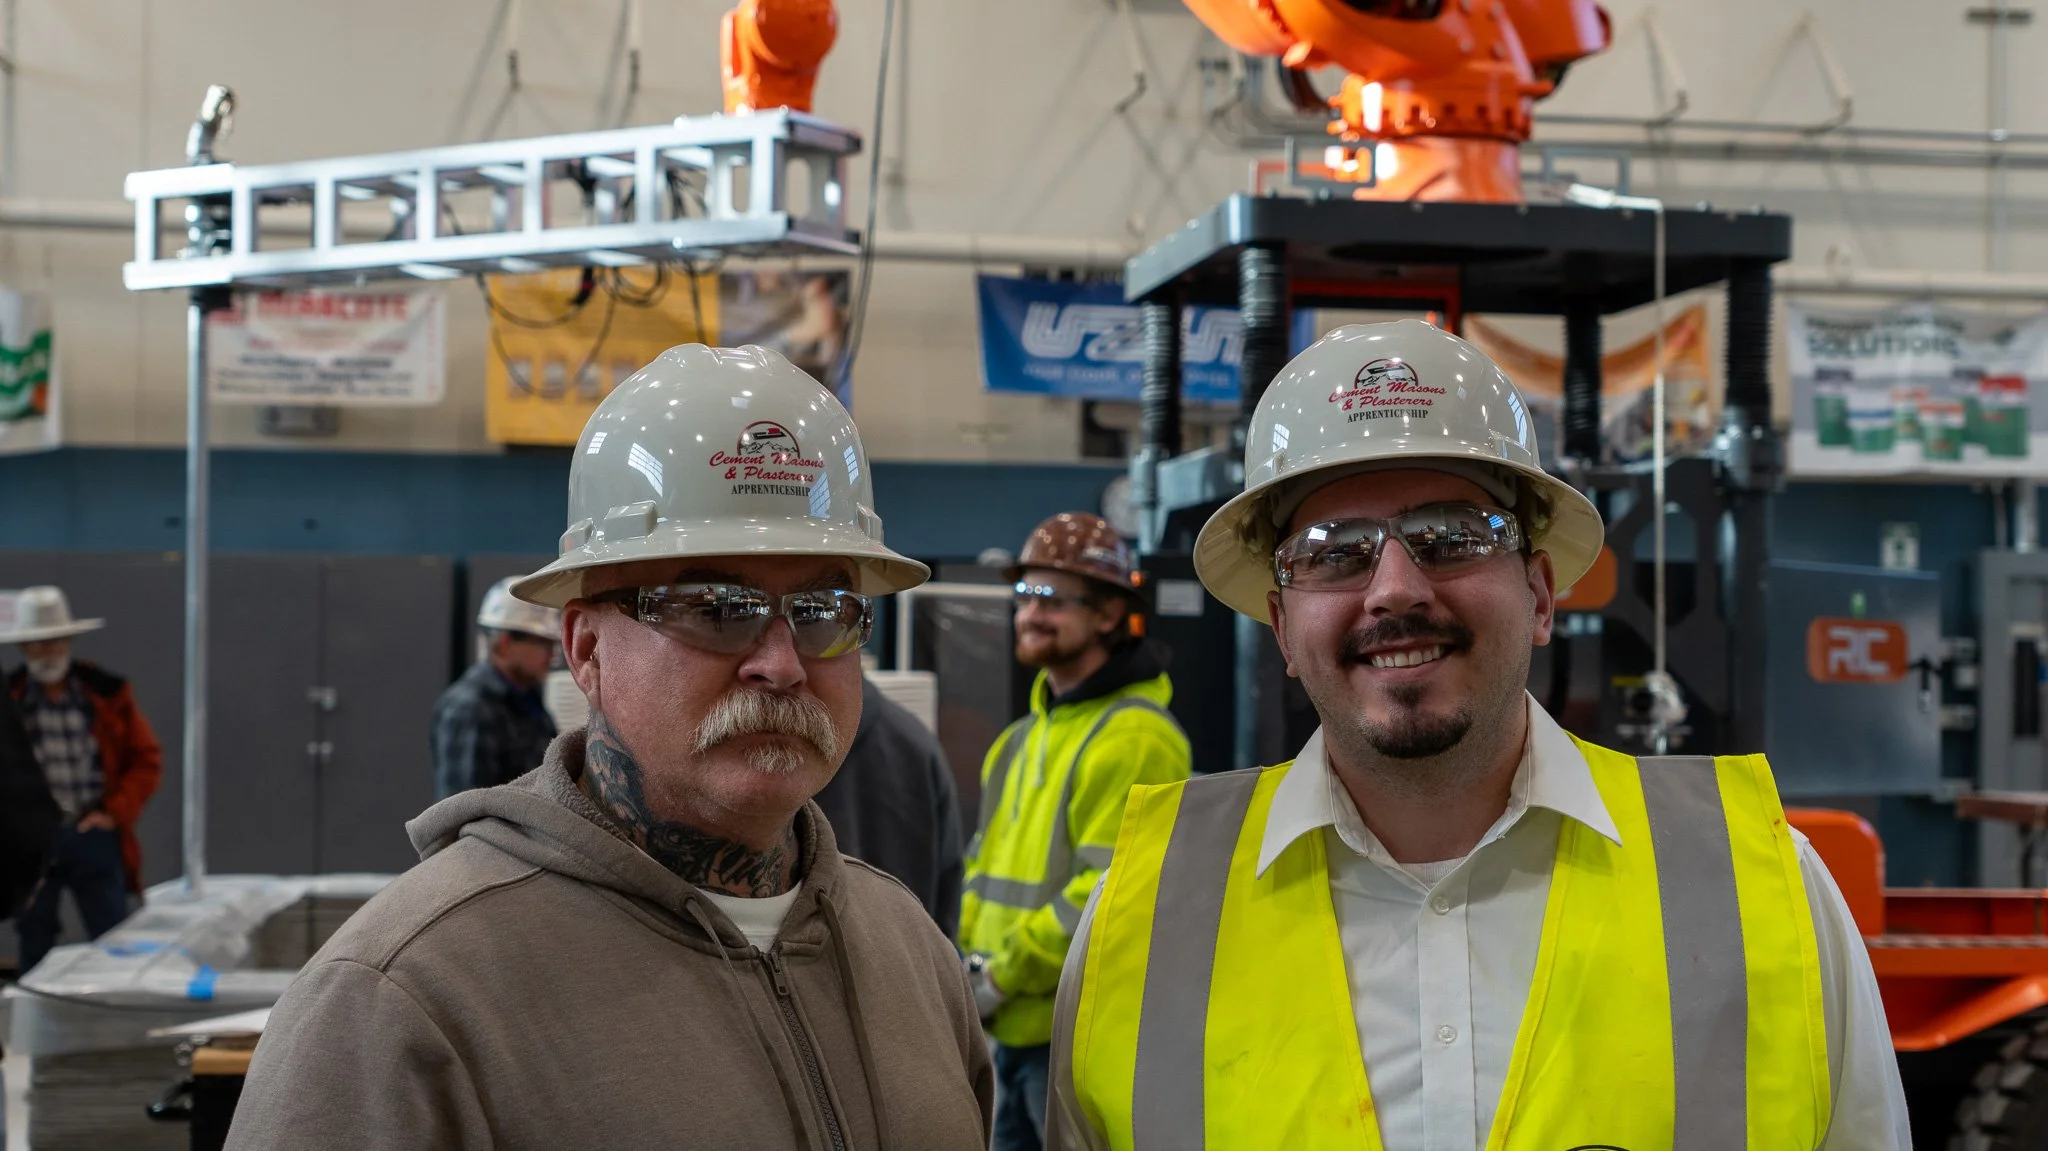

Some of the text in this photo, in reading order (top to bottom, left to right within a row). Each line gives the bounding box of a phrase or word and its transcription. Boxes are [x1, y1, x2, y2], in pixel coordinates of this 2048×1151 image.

[1328, 382, 1447, 403] Cement Masons
[1341, 396, 1434, 411] & Plasterers
[1347, 409, 1429, 423] APPRENTICESHIP
[709, 450, 826, 469] Cement Masons
[724, 466, 815, 483] & Plasterers
[731, 484, 811, 497] APPRENTICESHIP
